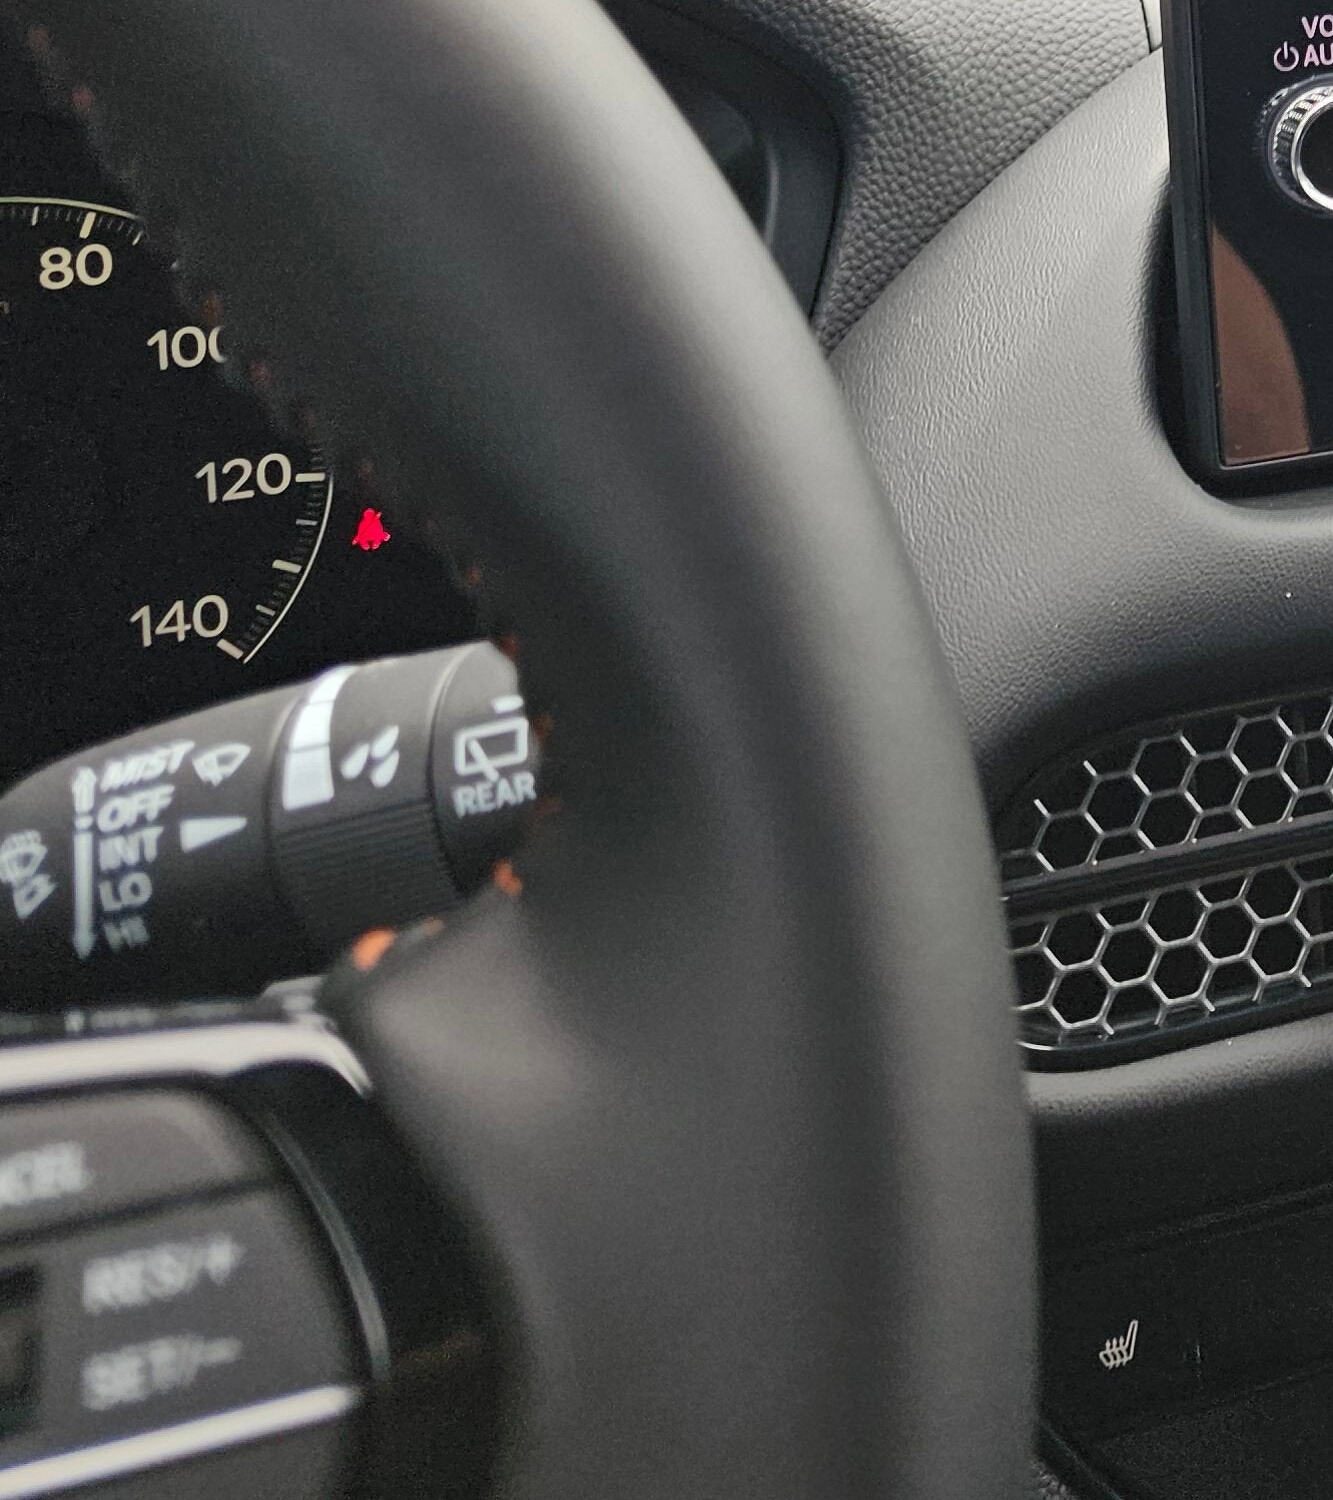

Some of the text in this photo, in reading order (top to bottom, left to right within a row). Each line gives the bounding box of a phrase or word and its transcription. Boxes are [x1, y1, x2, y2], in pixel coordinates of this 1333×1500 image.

[39, 244, 113, 290] 80
[195, 454, 292, 503] 120
[130, 595, 229, 647] 140
[97, 784, 176, 833] OFF
[453, 771, 537, 819] REAR
[100, 872, 152, 911] LO
